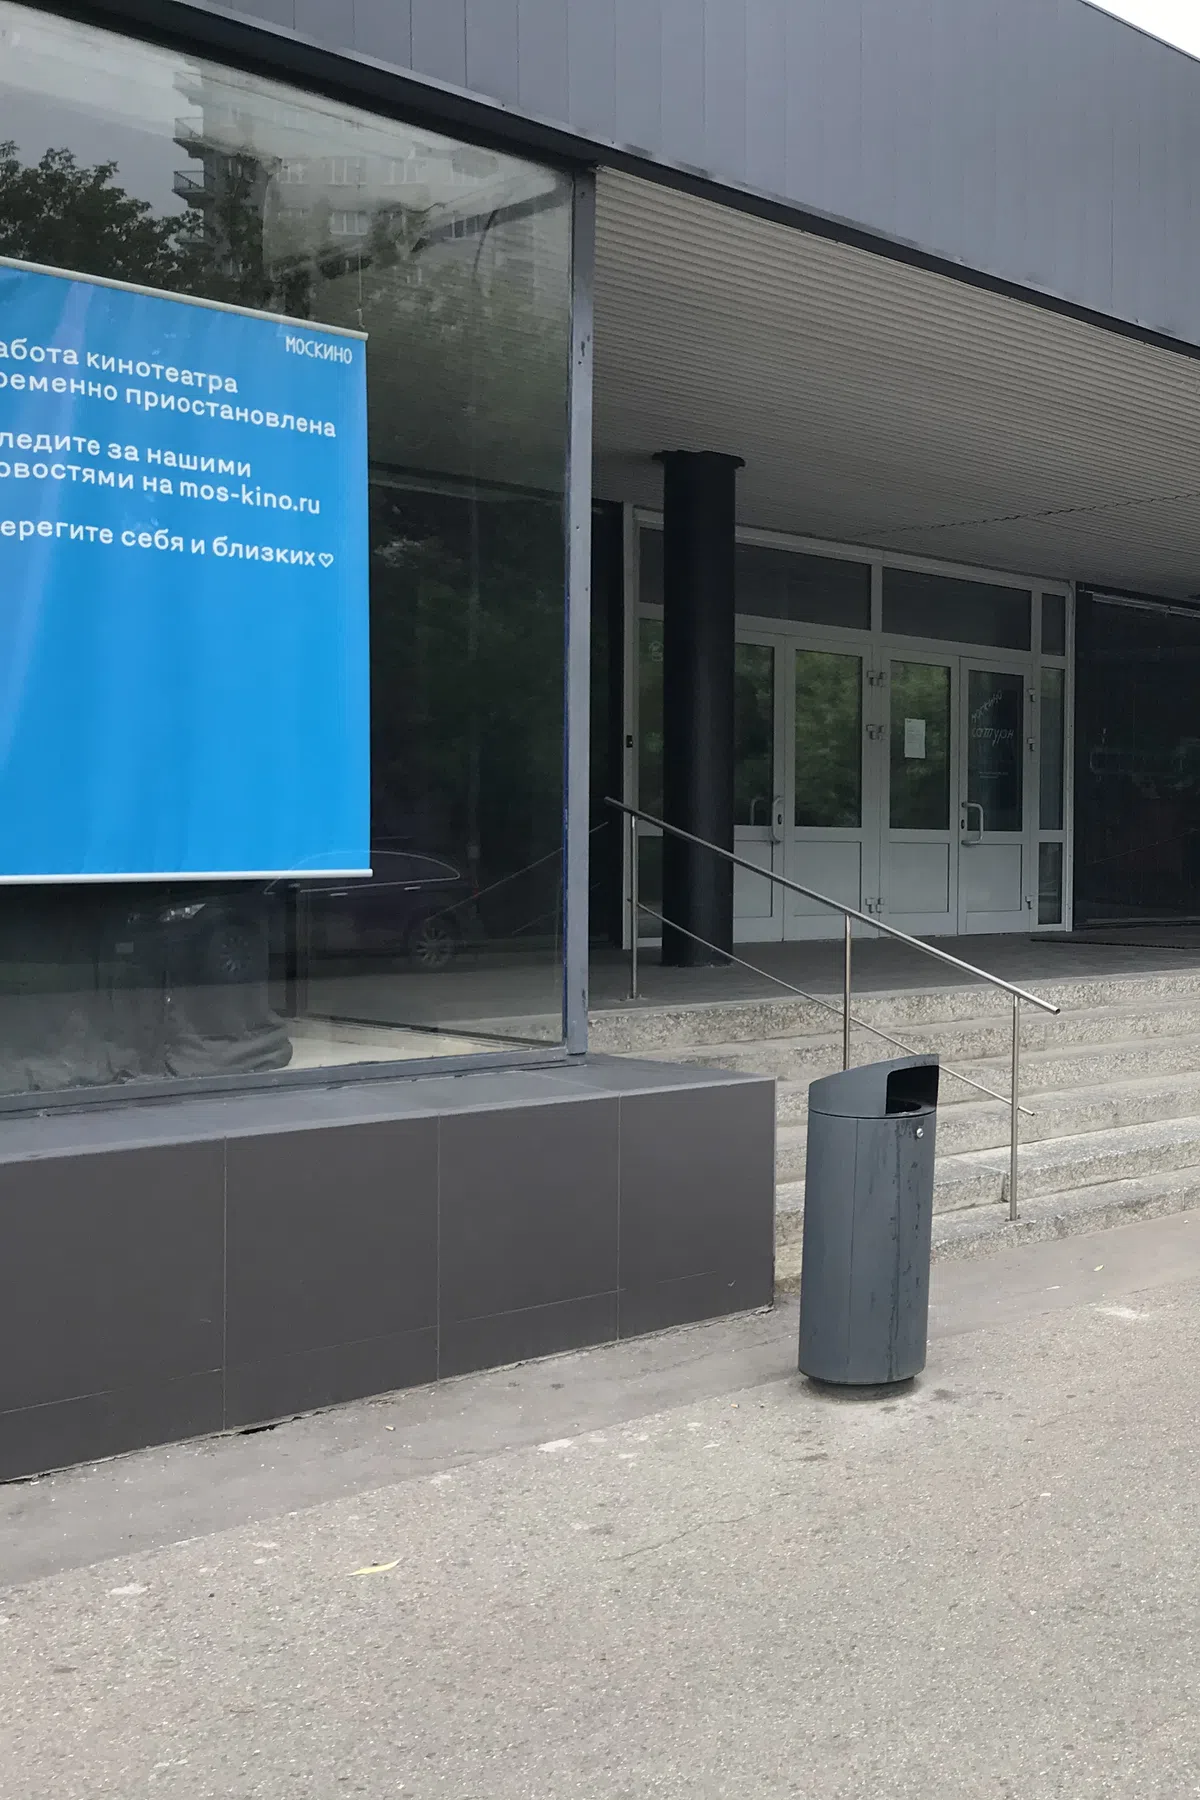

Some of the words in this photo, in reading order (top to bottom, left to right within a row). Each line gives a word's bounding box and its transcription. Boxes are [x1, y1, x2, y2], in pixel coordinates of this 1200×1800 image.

[286, 336, 353, 364] МОСКИНО
[87, 352, 239, 394] кинотеатра
[126, 388, 337, 438] приостановлена
[108, 443, 140, 462] за
[147, 448, 251, 478] нашими
[143, 475, 174, 495] на
[180, 480, 321, 515] mos-kino.ru
[0, 521, 113, 544] ерегите
[121, 529, 184, 553] себя
[191, 539, 206, 555] и
[212, 536, 316, 568] близких
